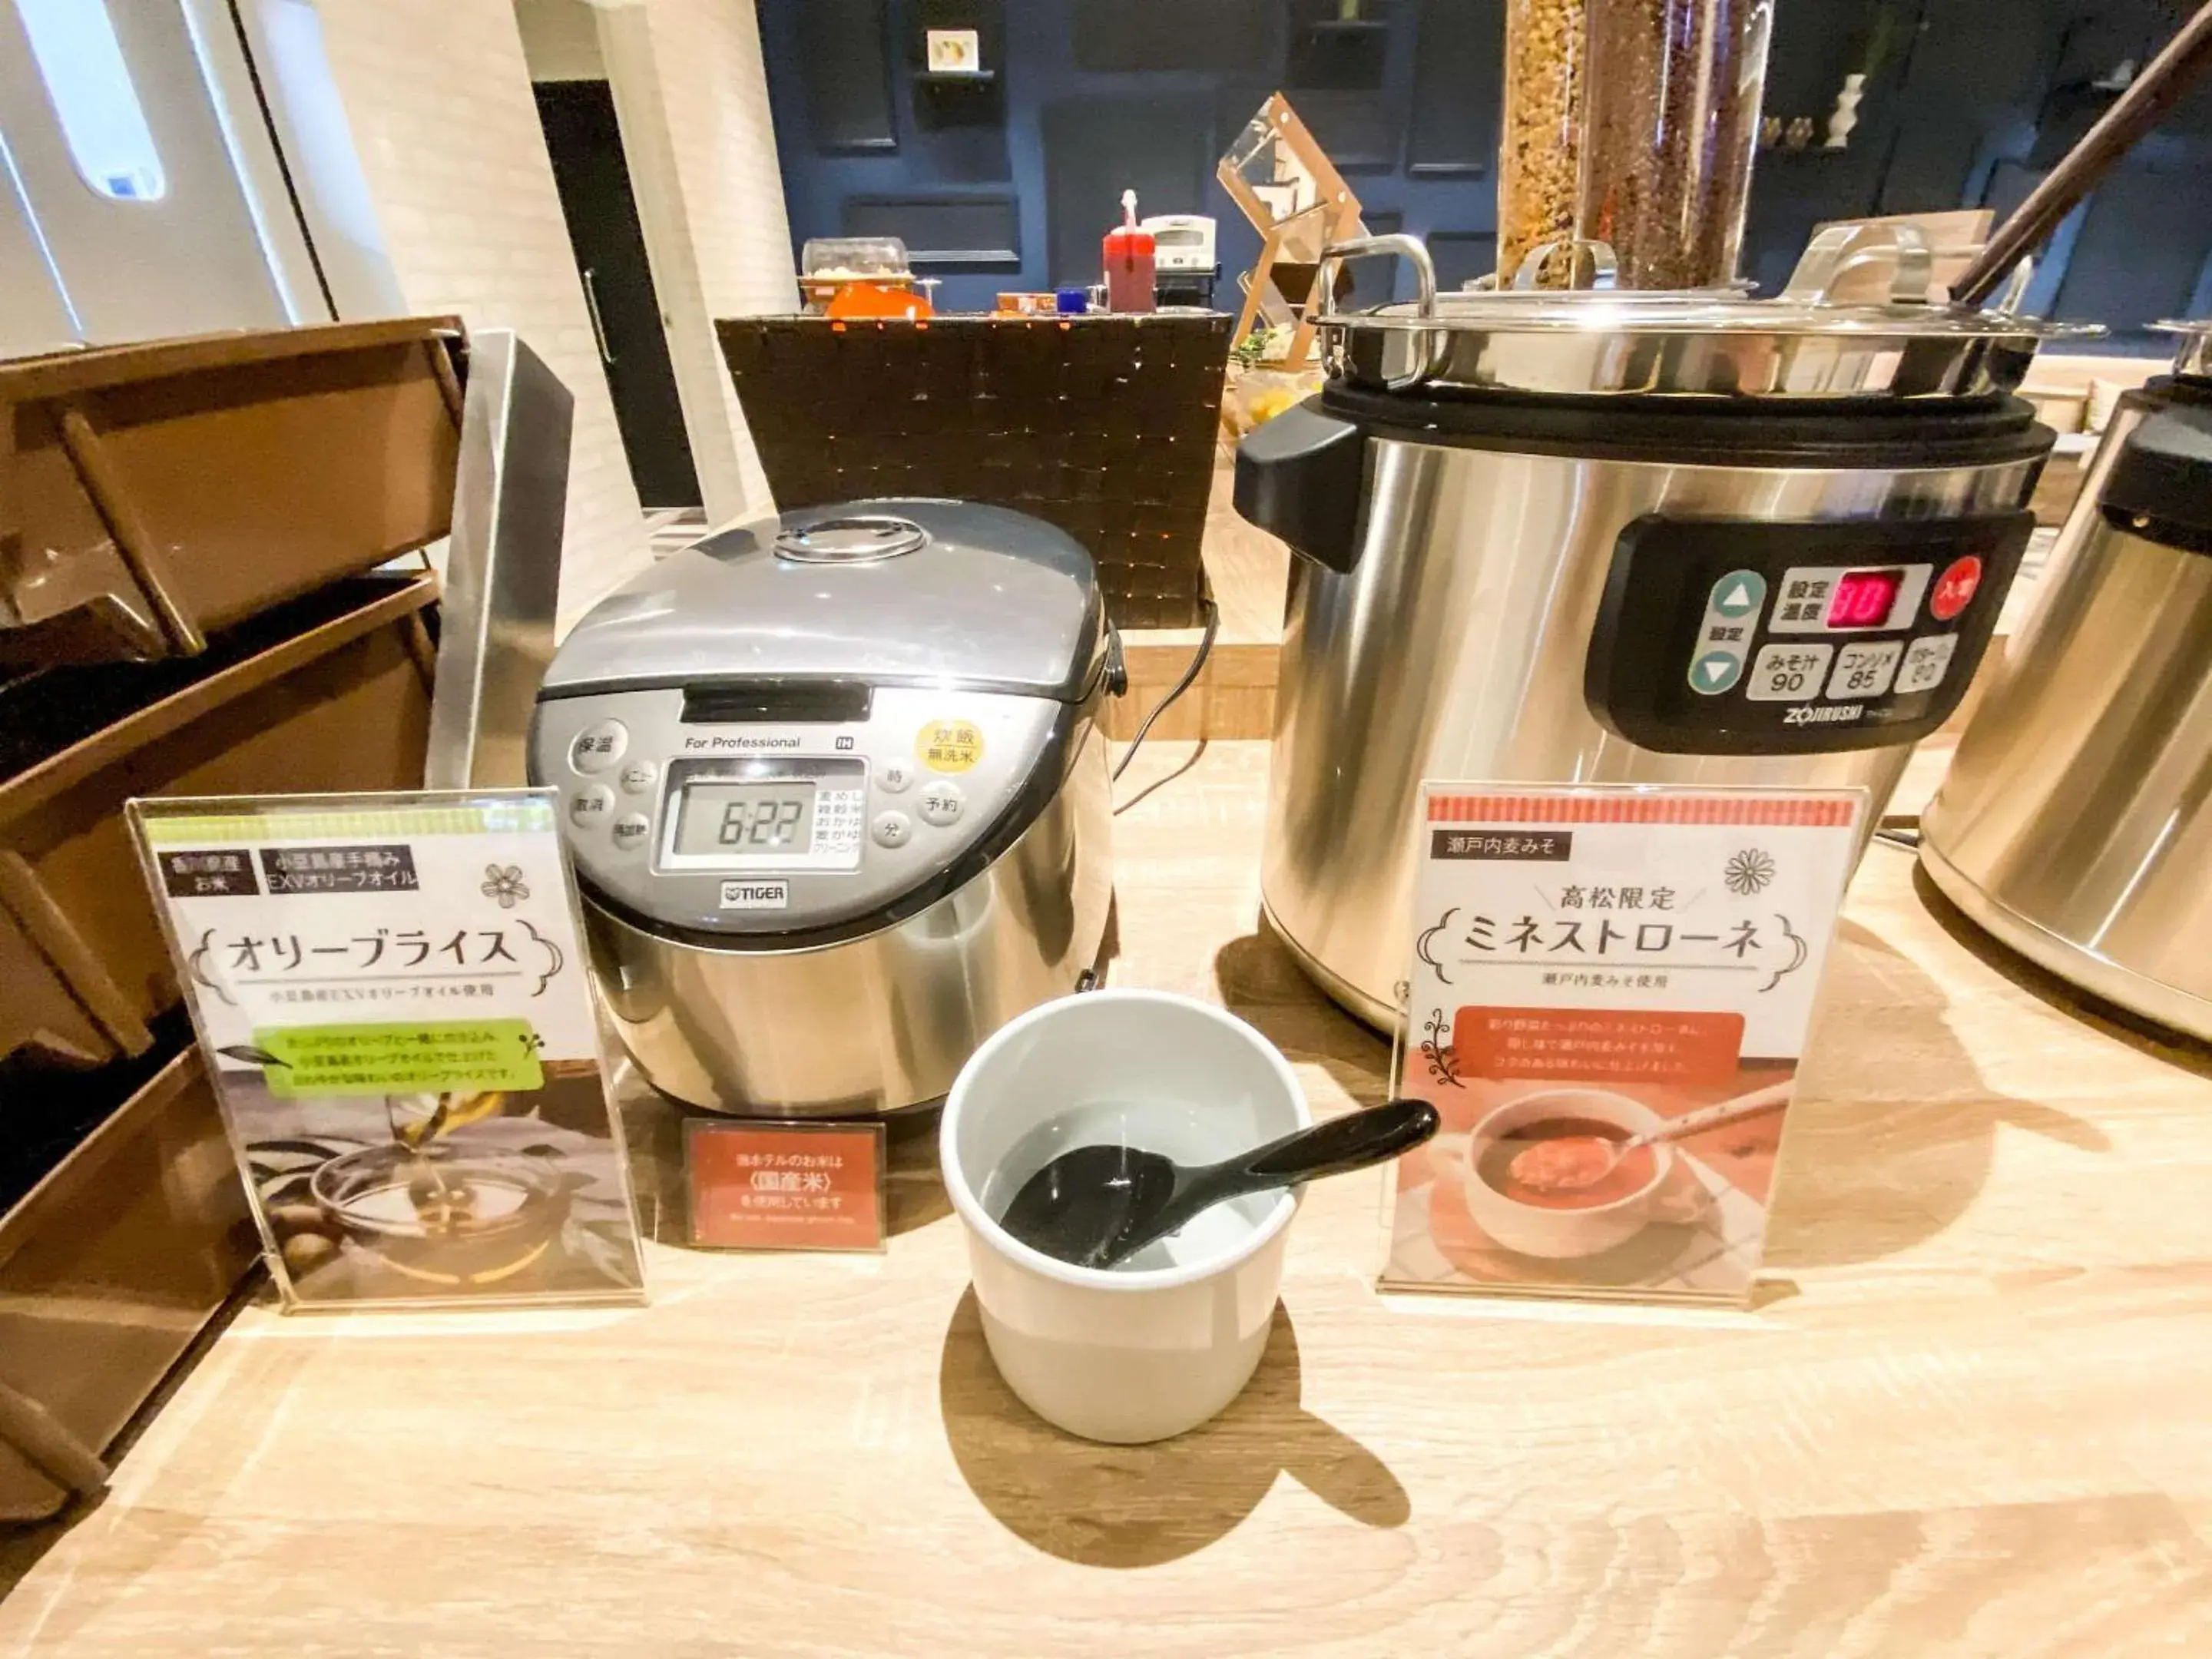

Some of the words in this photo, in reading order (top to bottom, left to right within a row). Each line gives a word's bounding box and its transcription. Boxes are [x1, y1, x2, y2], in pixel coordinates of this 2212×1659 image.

[1787, 581, 1830, 599] 設定
[1780, 603, 1823, 621] 温度
[1708, 627, 1744, 641] 設定
[1766, 655, 1820, 672] みそ汁
[1771, 673, 1806, 692] 90
[1846, 670, 1877, 690] 85
[577, 735, 614, 754] 保温
[685, 737, 707, 750] For
[712, 736, 801, 749] Professional
[928, 748, 977, 763] 無洗米
[926, 796, 958, 813] 予約
[718, 801, 803, 845] 6:22
[885, 822, 901, 838] 分
[1447, 836, 1556, 856] 瀬戸内麦みそ
[194, 876, 230, 891] お米
[741, 886, 784, 901] TIGER
[1561, 886, 1677, 910] 高松限定
[1464, 914, 1763, 959] ミネストローネ
[227, 928, 518, 971] オリーブライス
[1542, 973, 1668, 989] 瀬戸内麦みそ使用
